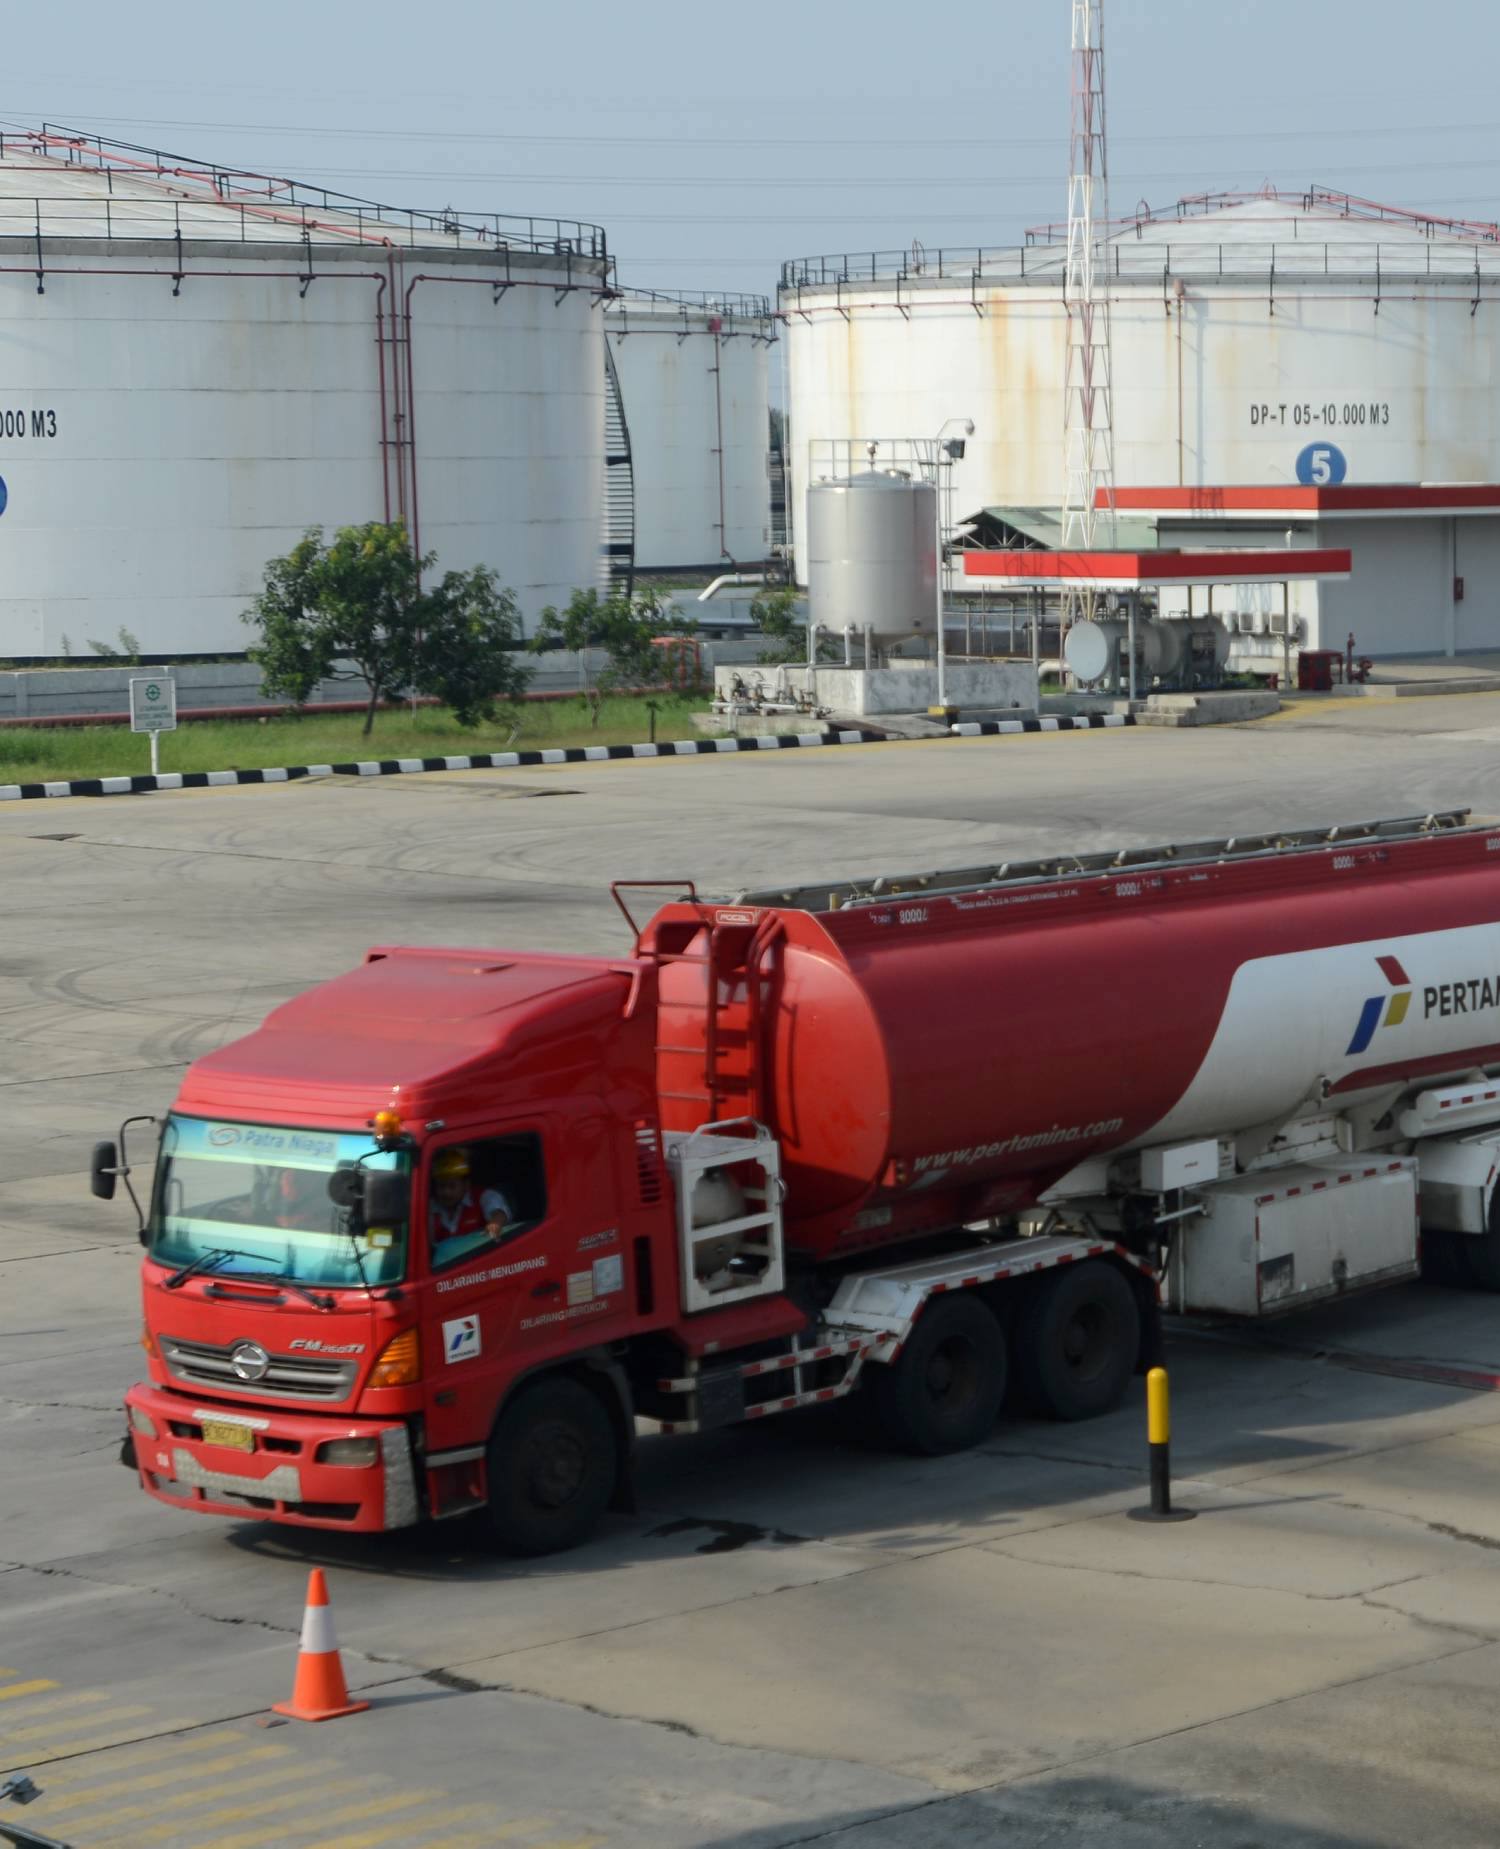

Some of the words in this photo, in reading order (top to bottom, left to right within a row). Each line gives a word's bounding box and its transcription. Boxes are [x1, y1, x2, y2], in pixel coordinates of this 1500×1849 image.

[32, 410, 57, 438] M3
[1250, 404, 1287, 424] DP-T
[1311, 449, 1331, 484] 5
[244, 1130, 285, 1148] Patra
[914, 1117, 1123, 1172] www.pertamina.com
[436, 1272, 487, 1293] DILARANG
[490, 1256, 546, 1279] MENUMPANG
[520, 1311, 565, 1330] DILARANG
